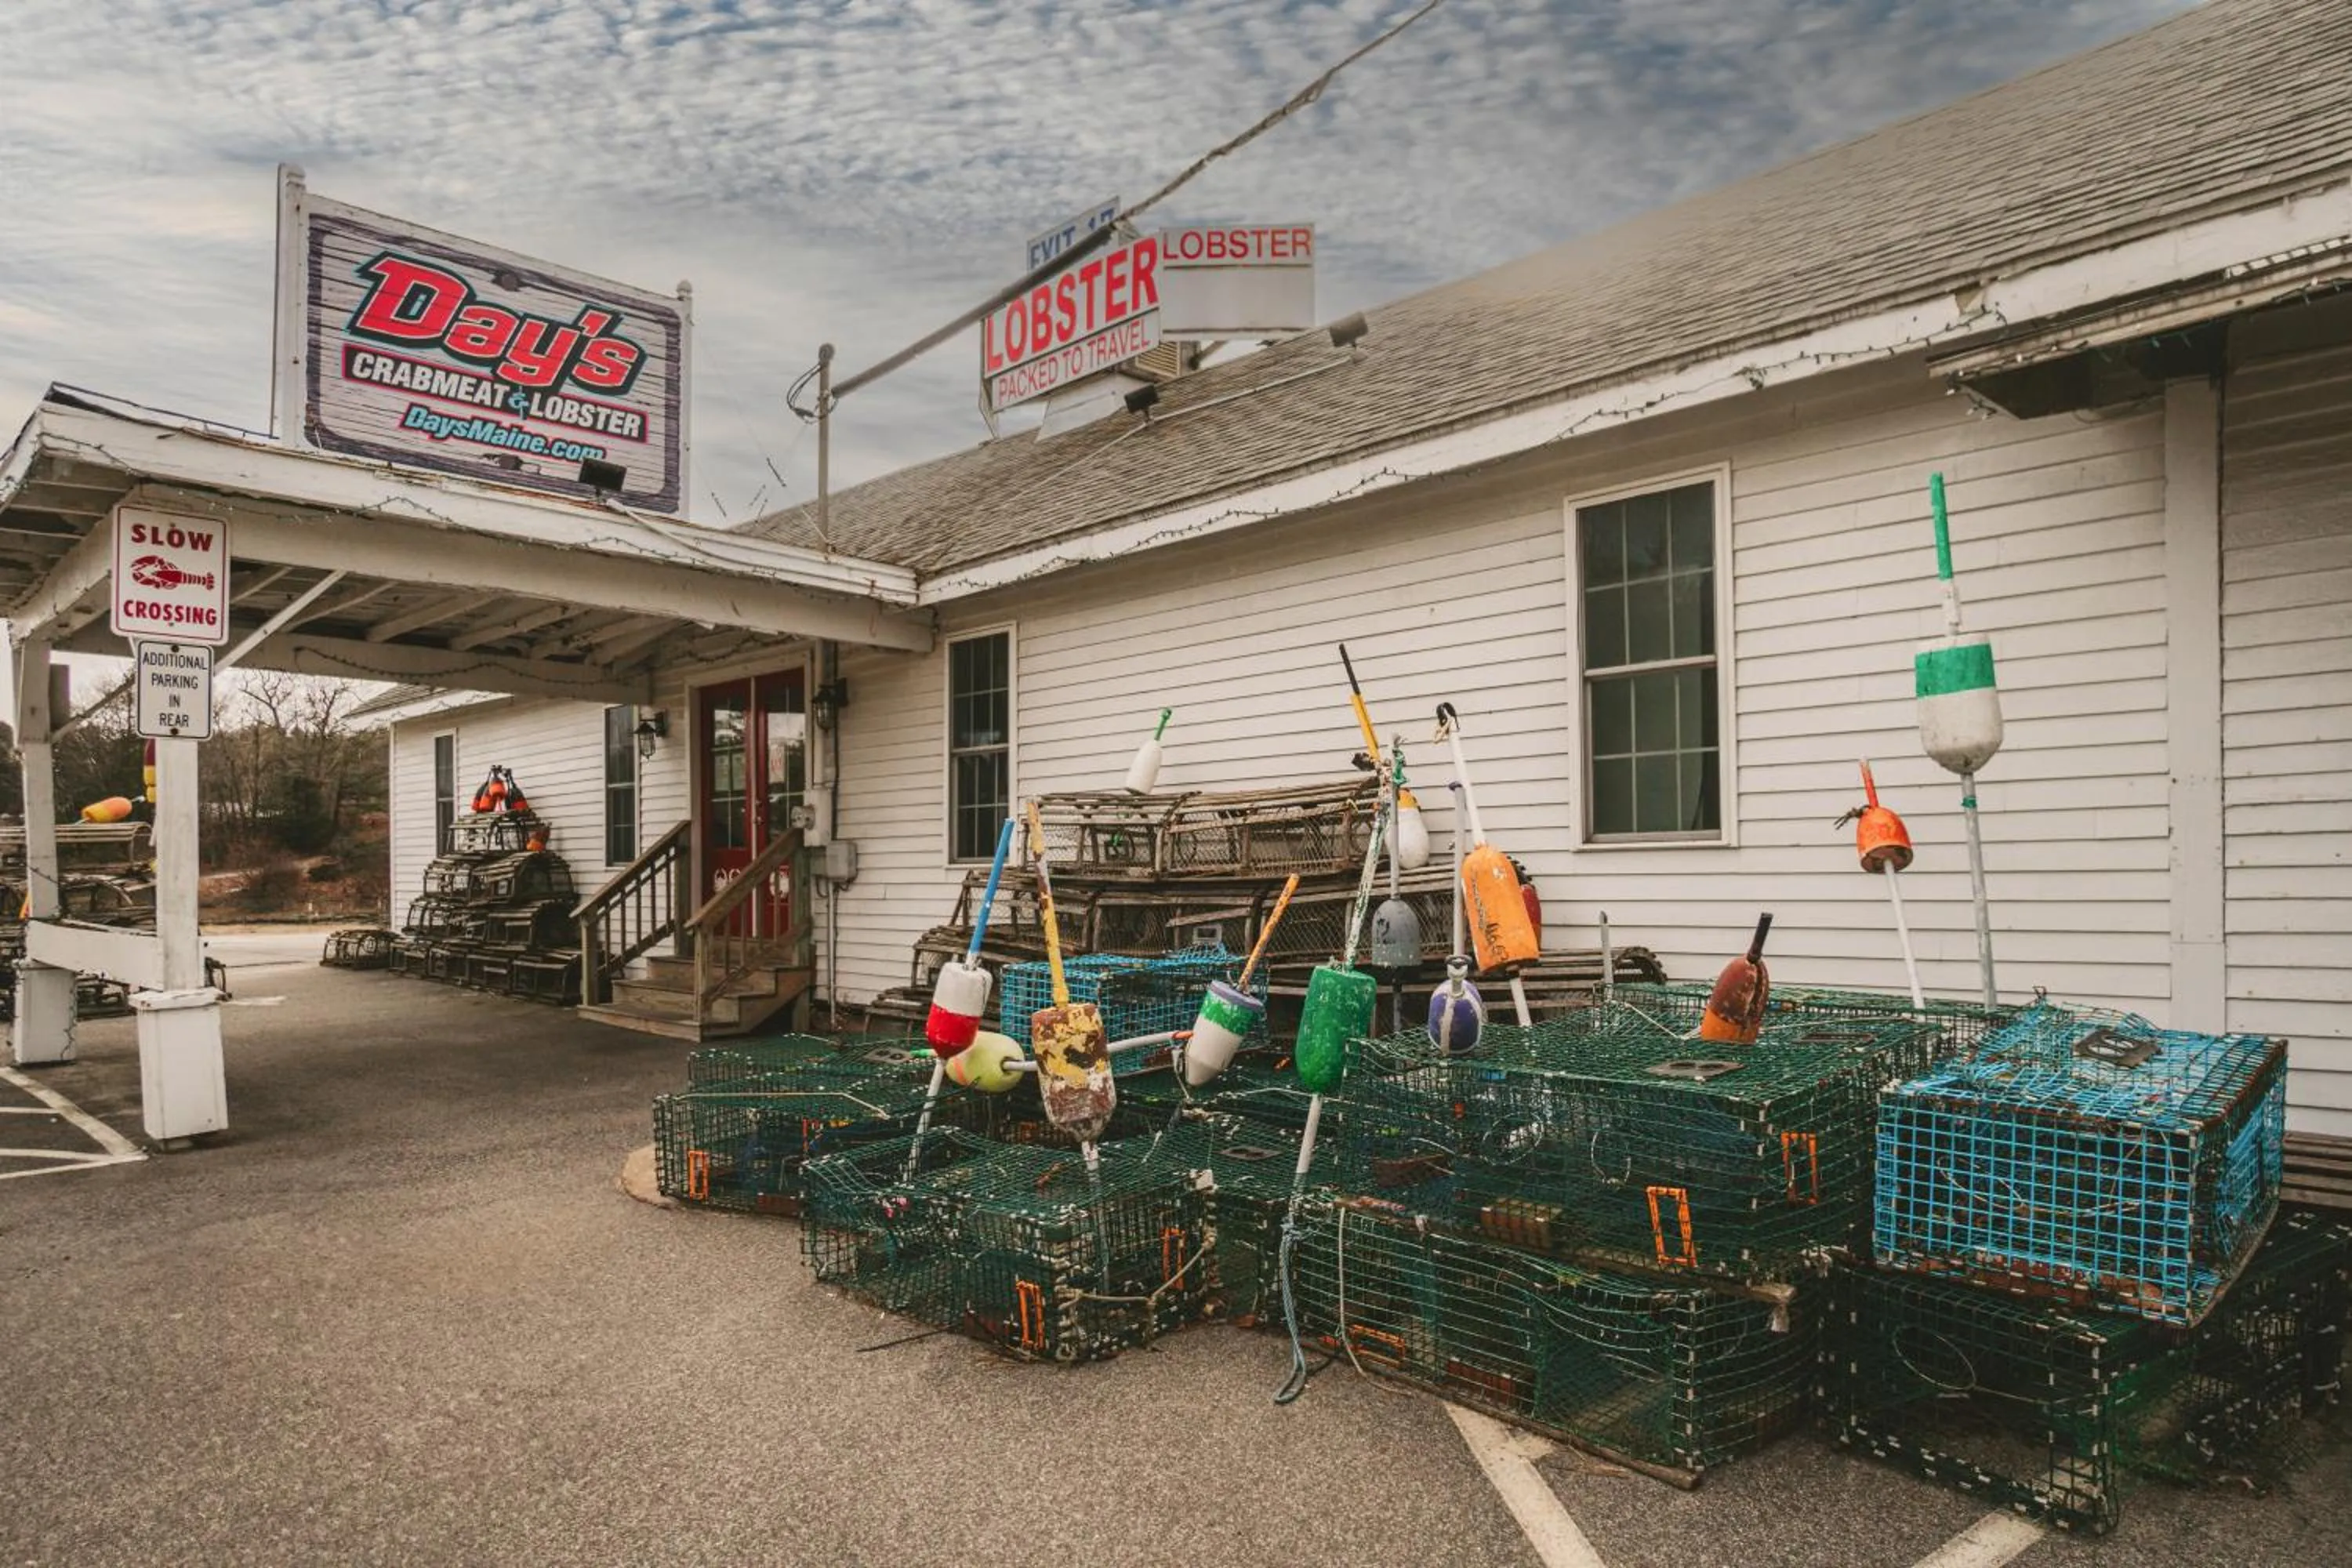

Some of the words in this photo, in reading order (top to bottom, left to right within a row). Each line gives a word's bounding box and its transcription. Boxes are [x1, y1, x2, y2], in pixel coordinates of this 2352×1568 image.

[1162, 228, 1312, 260] LOBSTER
[985, 236, 1160, 372] LOBSTER
[353, 255, 641, 388] Day's
[998, 356, 1059, 405] PACKED
[1063, 345, 1083, 376] TO
[1087, 318, 1151, 368] TRAVEL
[351, 351, 510, 408] CRABMEAT
[528, 392, 643, 438] LOBSTER
[403, 405, 604, 460] DaysMaine.com
[131, 523, 214, 552] SLOW
[123, 599, 217, 626] CROSSING
[142, 652, 208, 670] ADDITIONAL
[151, 670, 198, 690] PARKING
[169, 694, 181, 707] IN
[159, 713, 189, 728] REAR
